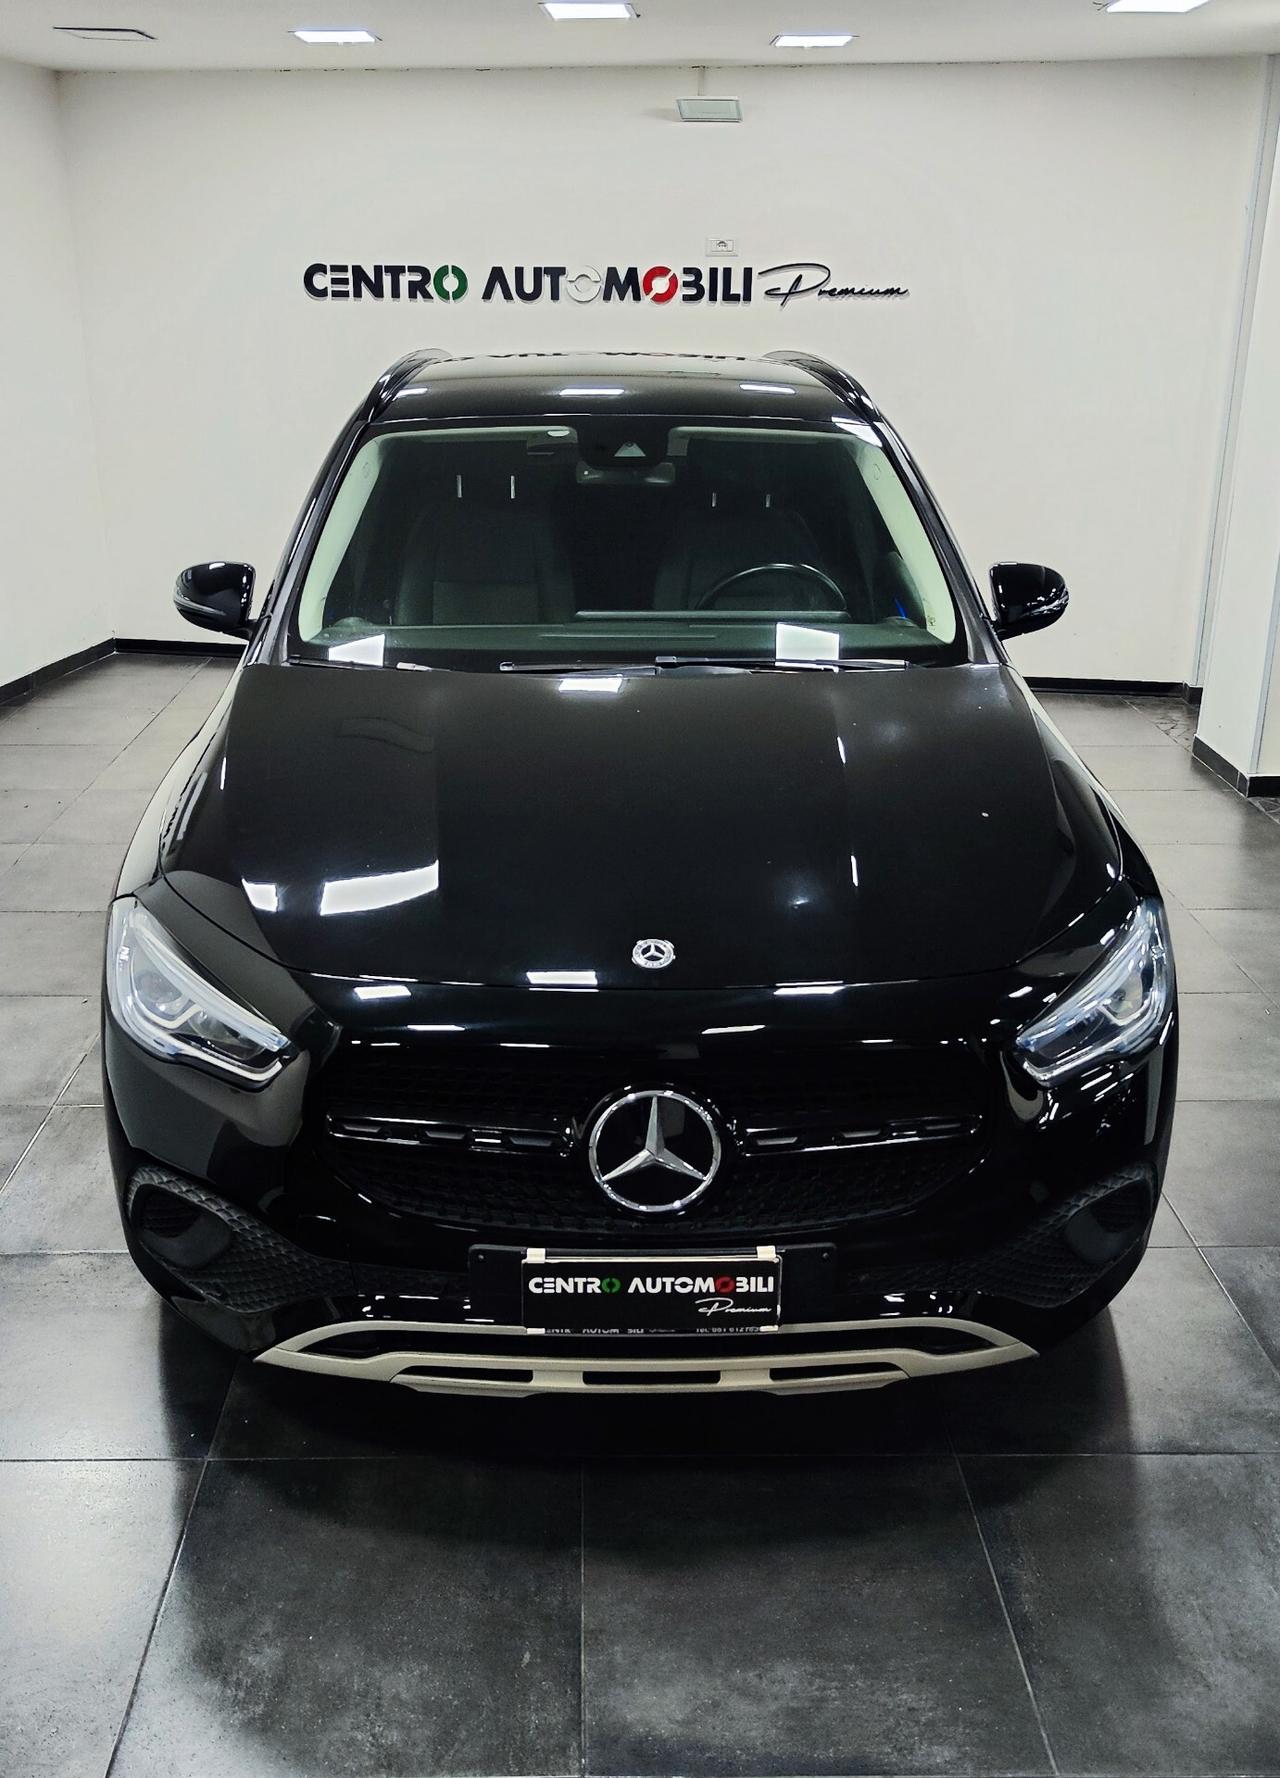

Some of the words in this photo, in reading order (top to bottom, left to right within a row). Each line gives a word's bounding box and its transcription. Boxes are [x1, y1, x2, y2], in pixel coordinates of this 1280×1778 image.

[303, 263, 469, 301] CENTRO
[481, 265, 753, 303] AUTOMOBILI
[757, 262, 909, 307] Premium
[528, 1276, 620, 1294] CENTRO
[627, 1276, 774, 1294] AUTOMOBILI
[694, 1297, 772, 1316] Premium
